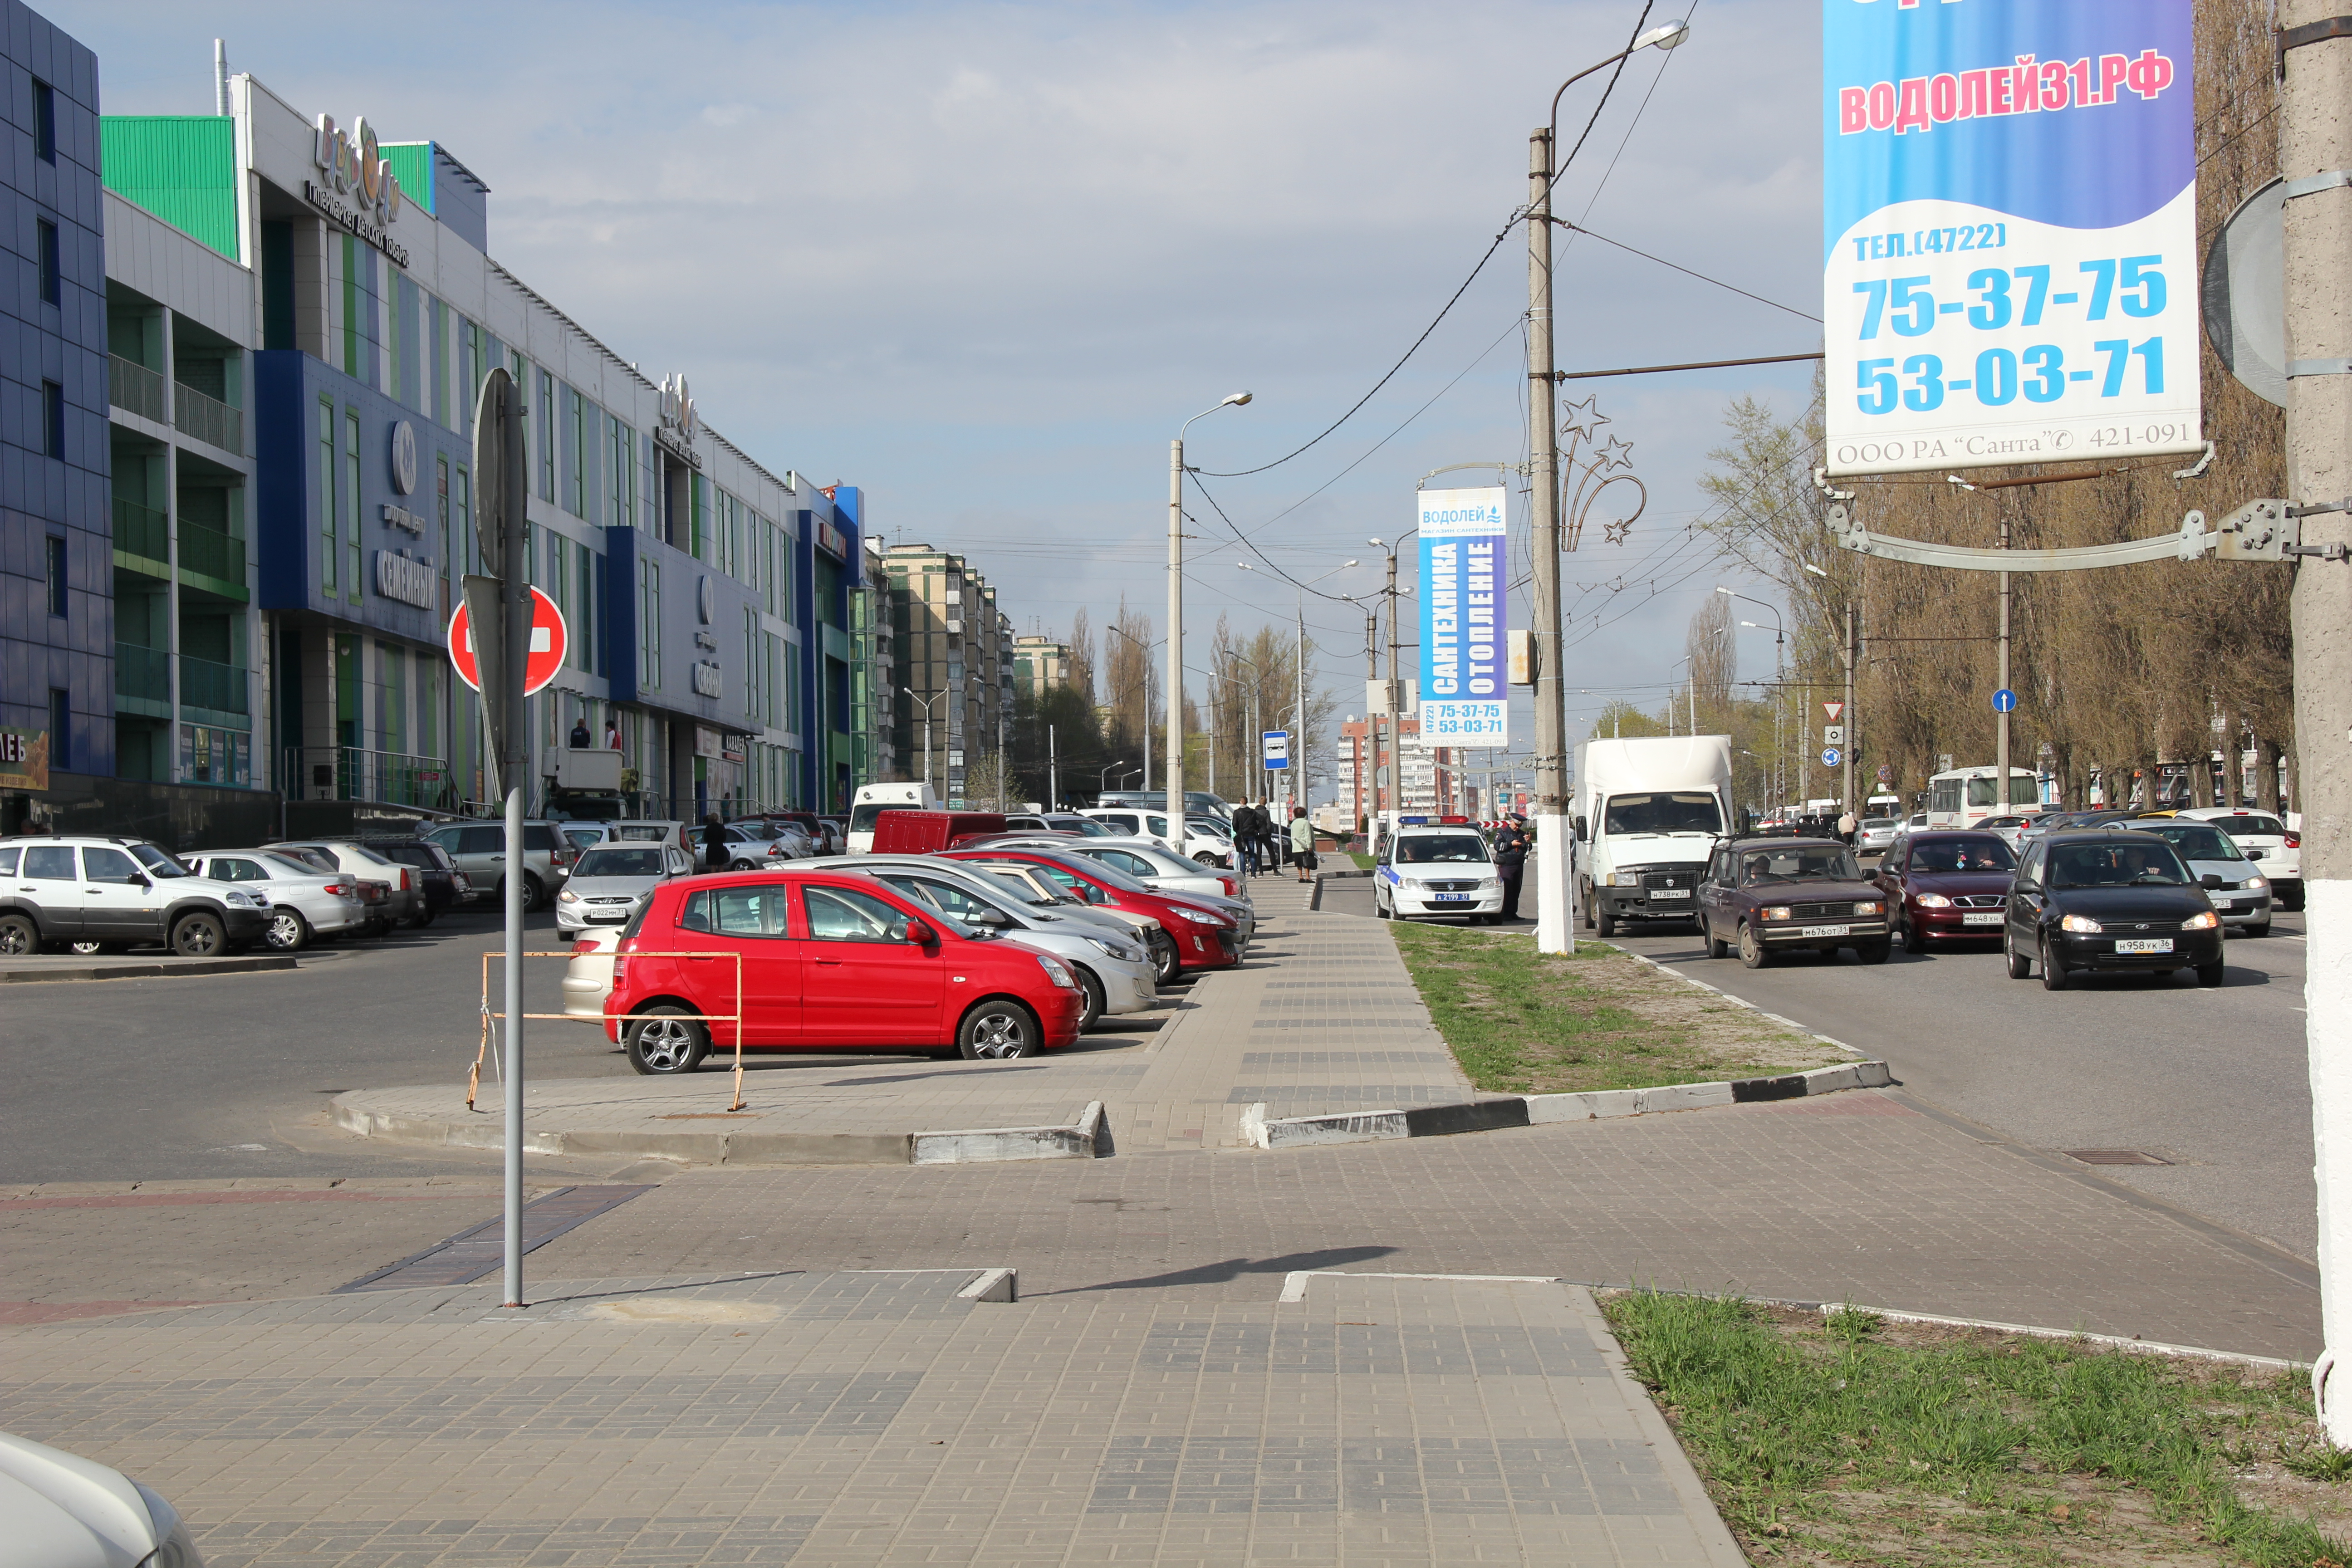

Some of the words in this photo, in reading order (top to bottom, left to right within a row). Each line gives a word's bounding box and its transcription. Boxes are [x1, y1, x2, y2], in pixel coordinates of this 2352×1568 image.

[1839, 49, 2174, 136] ВОДОЛЕЙ31.РФ
[1852, 223, 2006, 261] ТЕЛ.(4722)
[1852, 255, 2167, 340] 75-37-75
[1856, 337, 2164, 415] 53-03-71
[1837, 441, 1905, 464] ООО
[1912, 438, 1948, 459] РА
[2089, 423, 2190, 447] 421-091
[1423, 505, 1484, 525] ВОДОЛЕЙ
[379, 548, 435, 611] СЕМЕЙНЫЙ
[1432, 543, 1458, 695] САНТЕХНИКА
[1468, 543, 1495, 695] ОТОПЛЕНИЕ
[1426, 705, 1434, 733] (4722)
[1439, 705, 1499, 717] 75-37-75
[1439, 720, 1502, 733] 53-03-71
